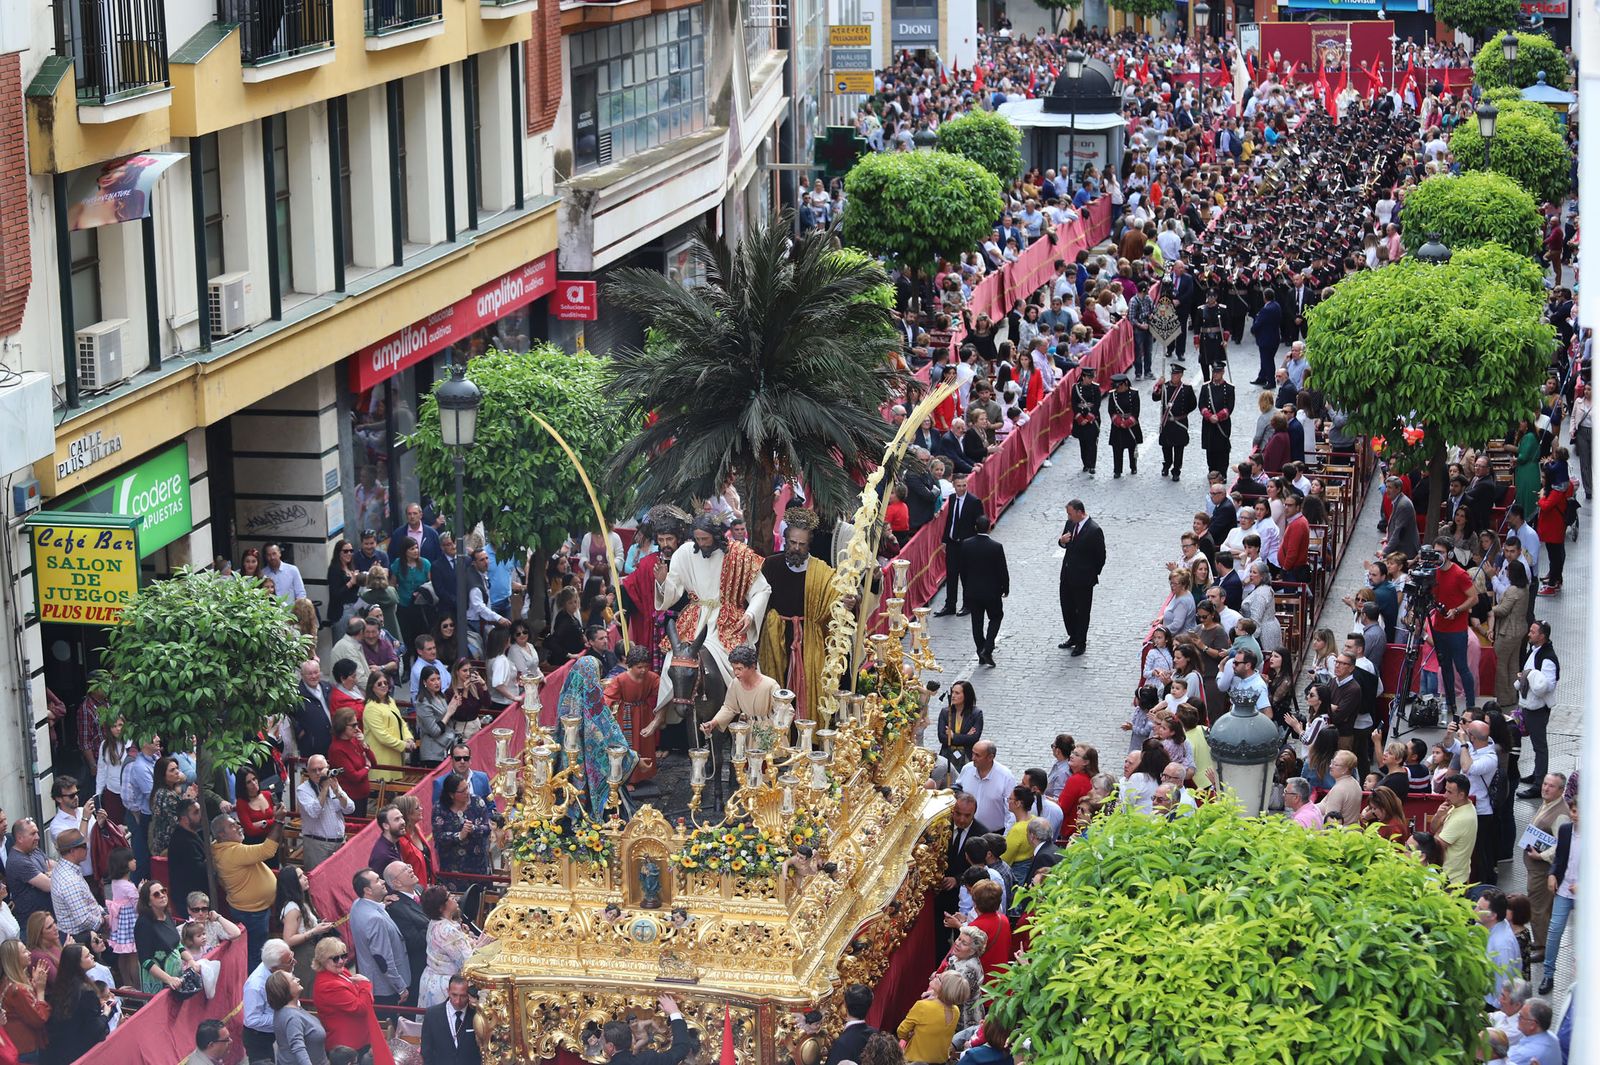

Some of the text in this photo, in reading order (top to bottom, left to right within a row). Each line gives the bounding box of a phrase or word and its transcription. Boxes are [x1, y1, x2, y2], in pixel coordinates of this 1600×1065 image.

[899, 23, 931, 35] DIONI
[524, 259, 546, 278] Soluciones
[525, 276, 545, 294] auditivas
[476, 276, 524, 317] amplifon
[428, 307, 454, 327] Soluciones
[429, 324, 452, 343] auditivas
[372, 326, 428, 371] amplifon
[70, 431, 102, 457] CALLE
[58, 436, 122, 479] PLUS ULTRA
[132, 473, 182, 515] codere
[142, 498, 183, 531] APUESTAS
[37, 528, 133, 554] Café Bar
[47, 555, 122, 573] SALON
[71, 573, 101, 587] DE
[44, 587, 129, 604] JUEGOS
[42, 604, 126, 622] PLUS ULTR
